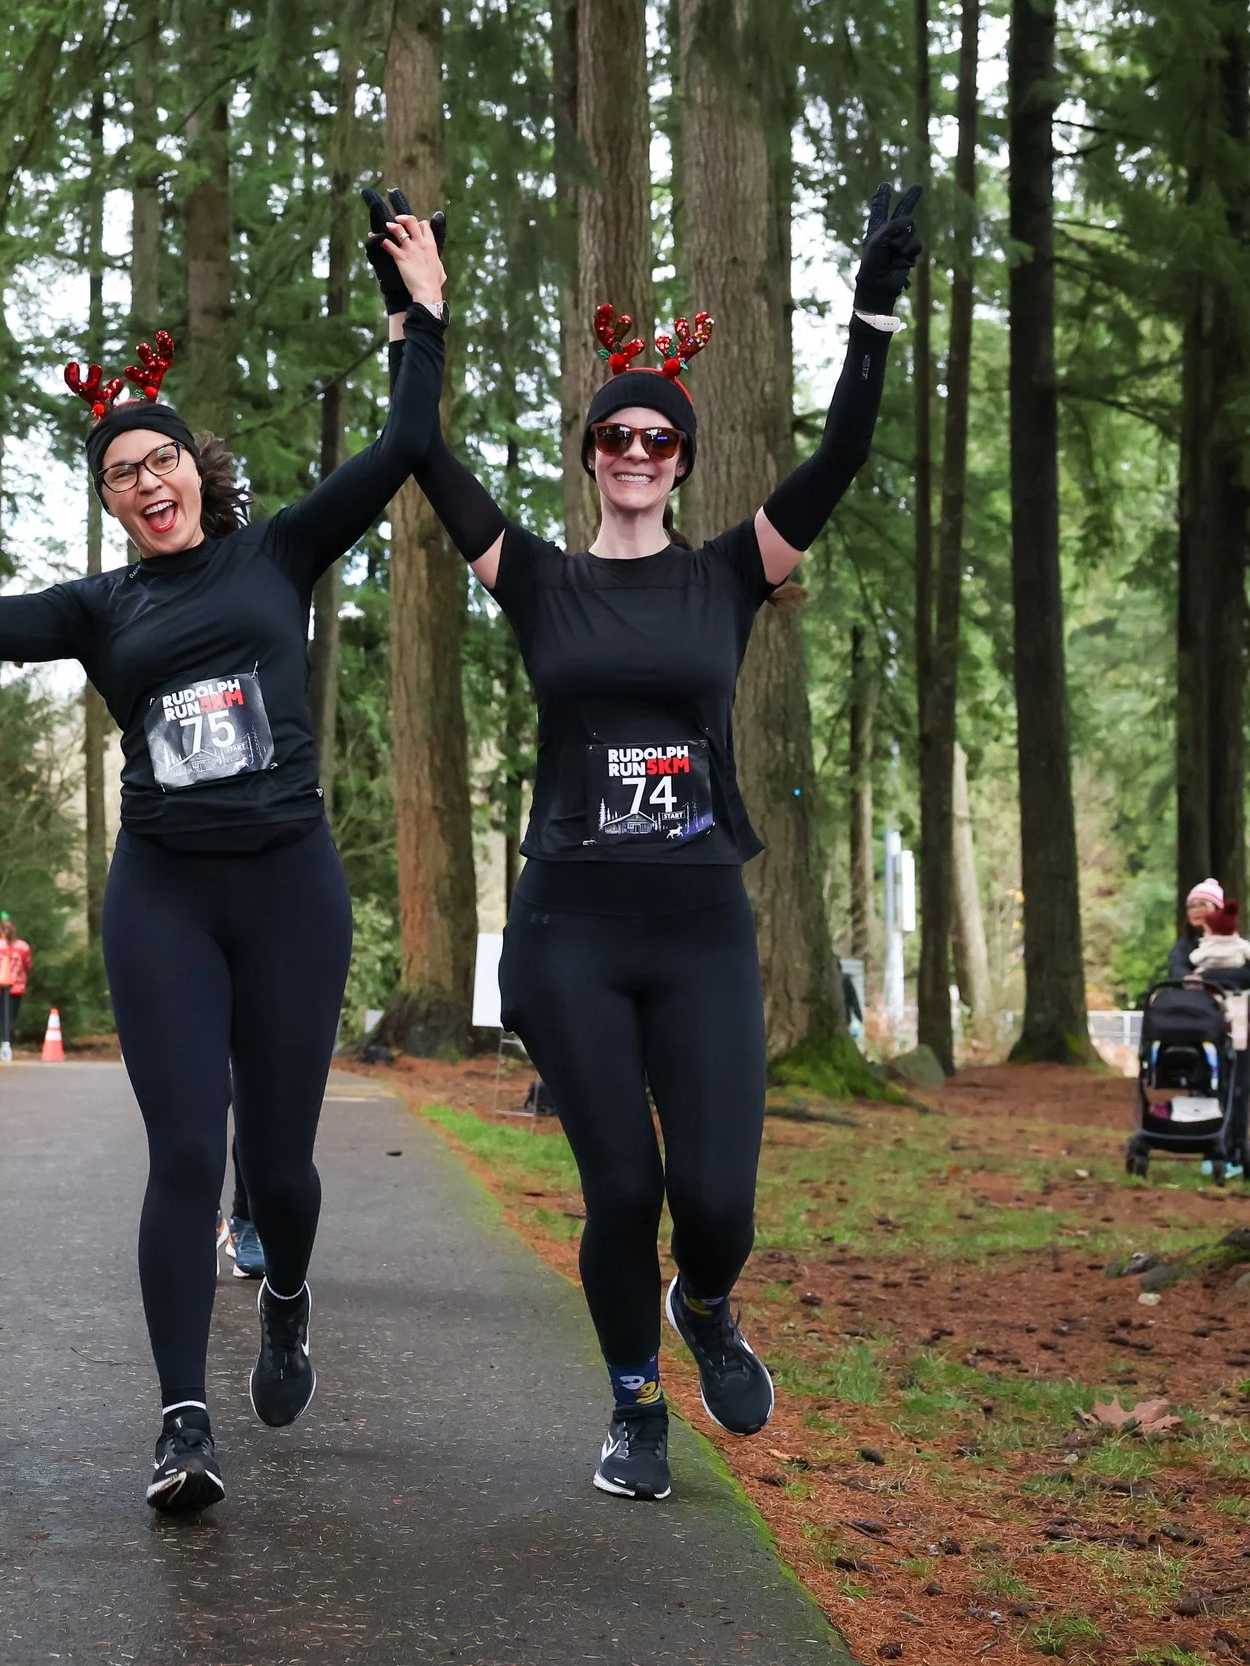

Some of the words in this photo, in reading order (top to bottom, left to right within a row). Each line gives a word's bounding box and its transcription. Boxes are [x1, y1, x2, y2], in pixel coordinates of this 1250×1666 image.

[162, 679, 241, 708] RUDOLPH
[180, 710, 236, 754] 75
[608, 746, 689, 763] RUDOLPH
[622, 775, 677, 814] 74
[663, 811, 684, 820] START
